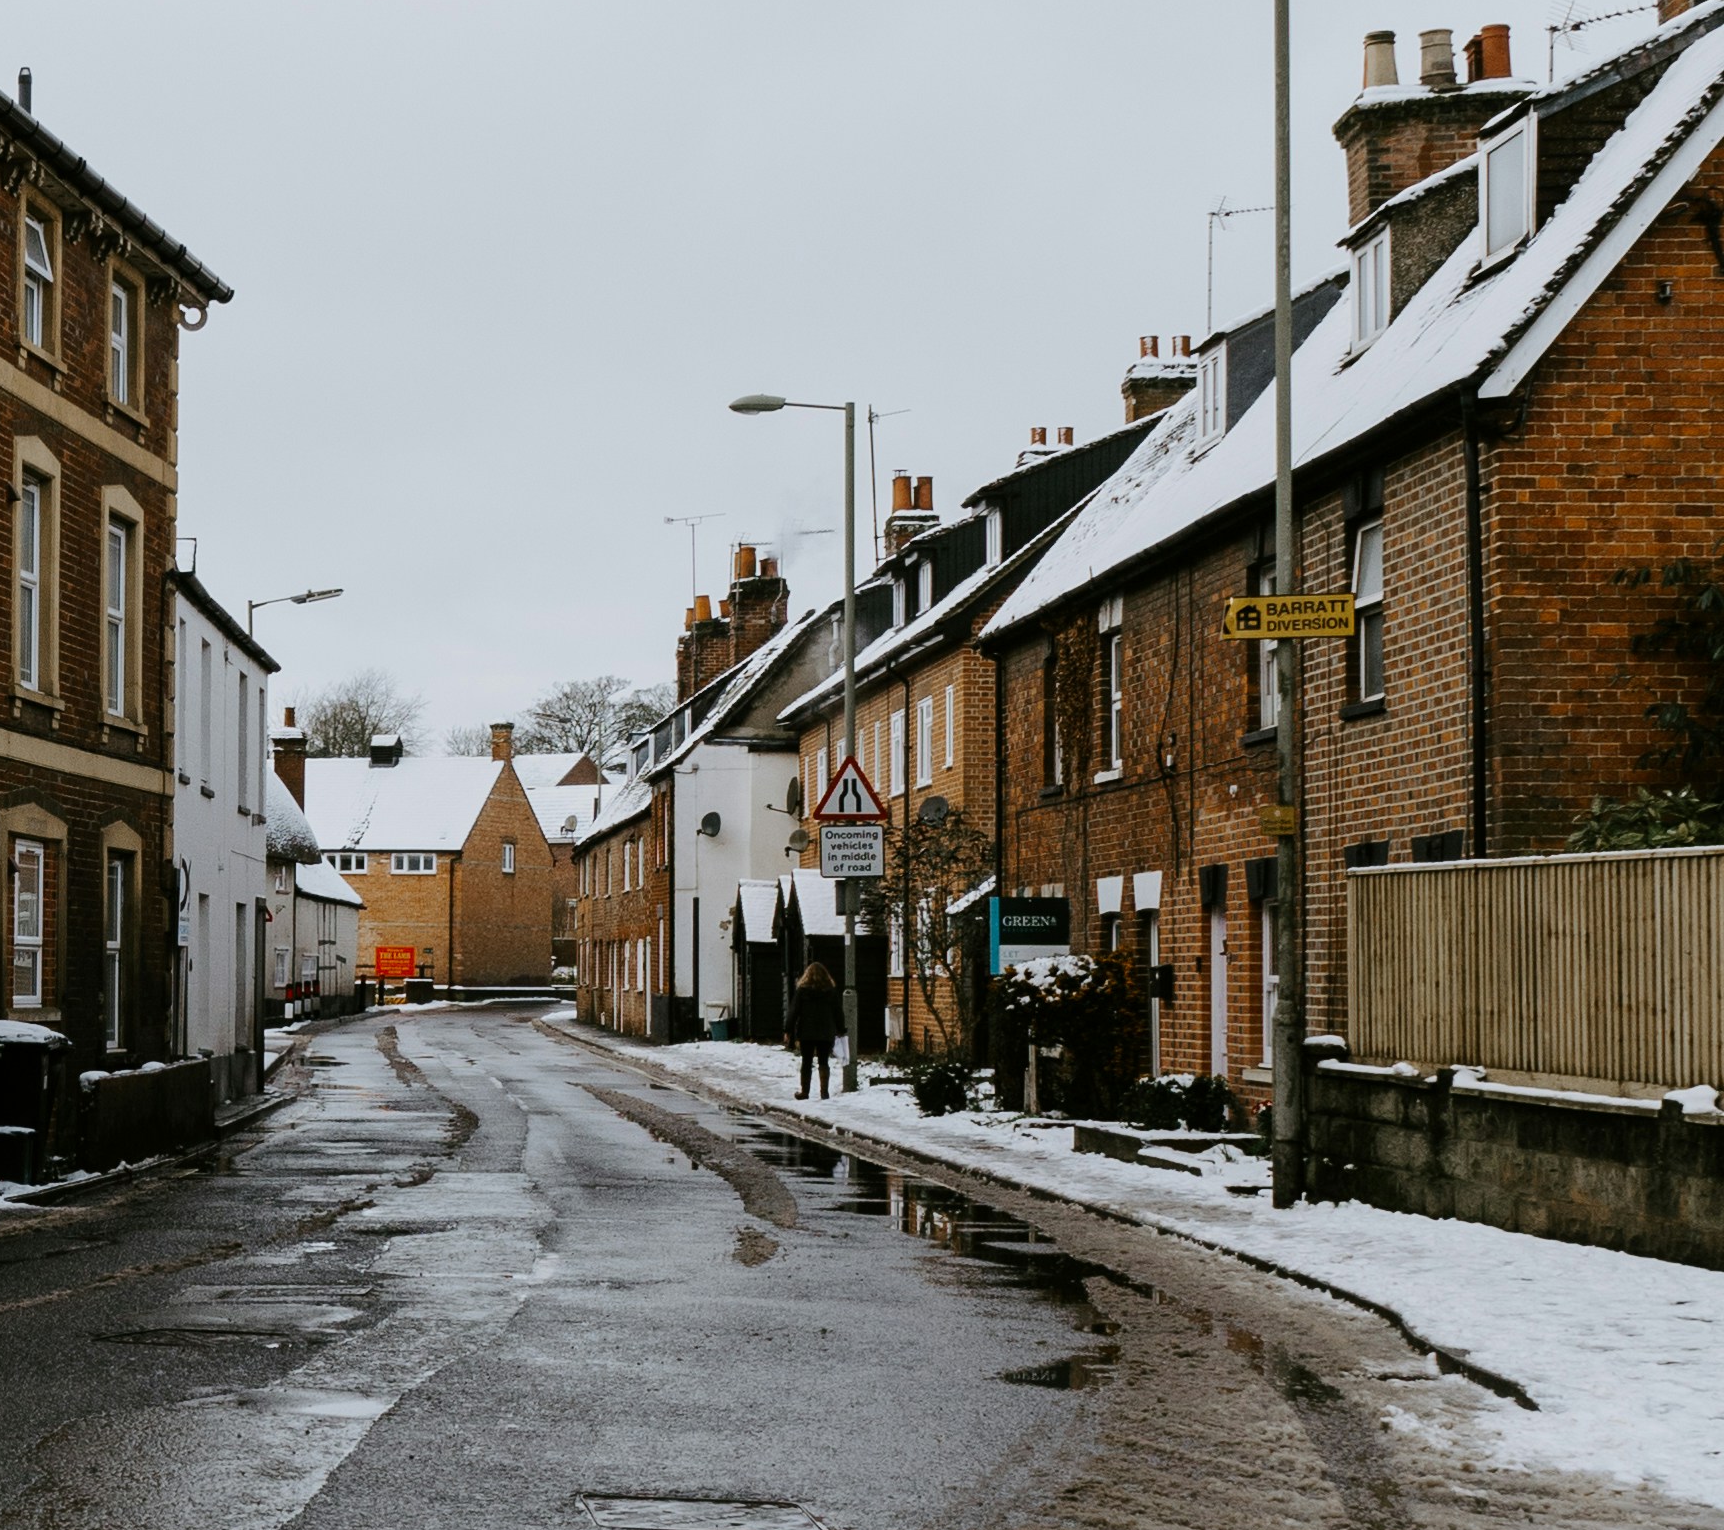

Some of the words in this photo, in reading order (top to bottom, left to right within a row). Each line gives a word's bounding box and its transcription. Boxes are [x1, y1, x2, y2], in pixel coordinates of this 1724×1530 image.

[1266, 599, 1349, 616] BARRATT
[1266, 617, 1349, 632] DIVERSION
[825, 830, 878, 840] Oncoming
[831, 841, 874, 850] vehicles
[827, 852, 838, 861] in
[841, 851, 877, 861] middle
[833, 863, 844, 872] of
[847, 862, 872, 872] road
[1002, 915, 1050, 927] GREEN
